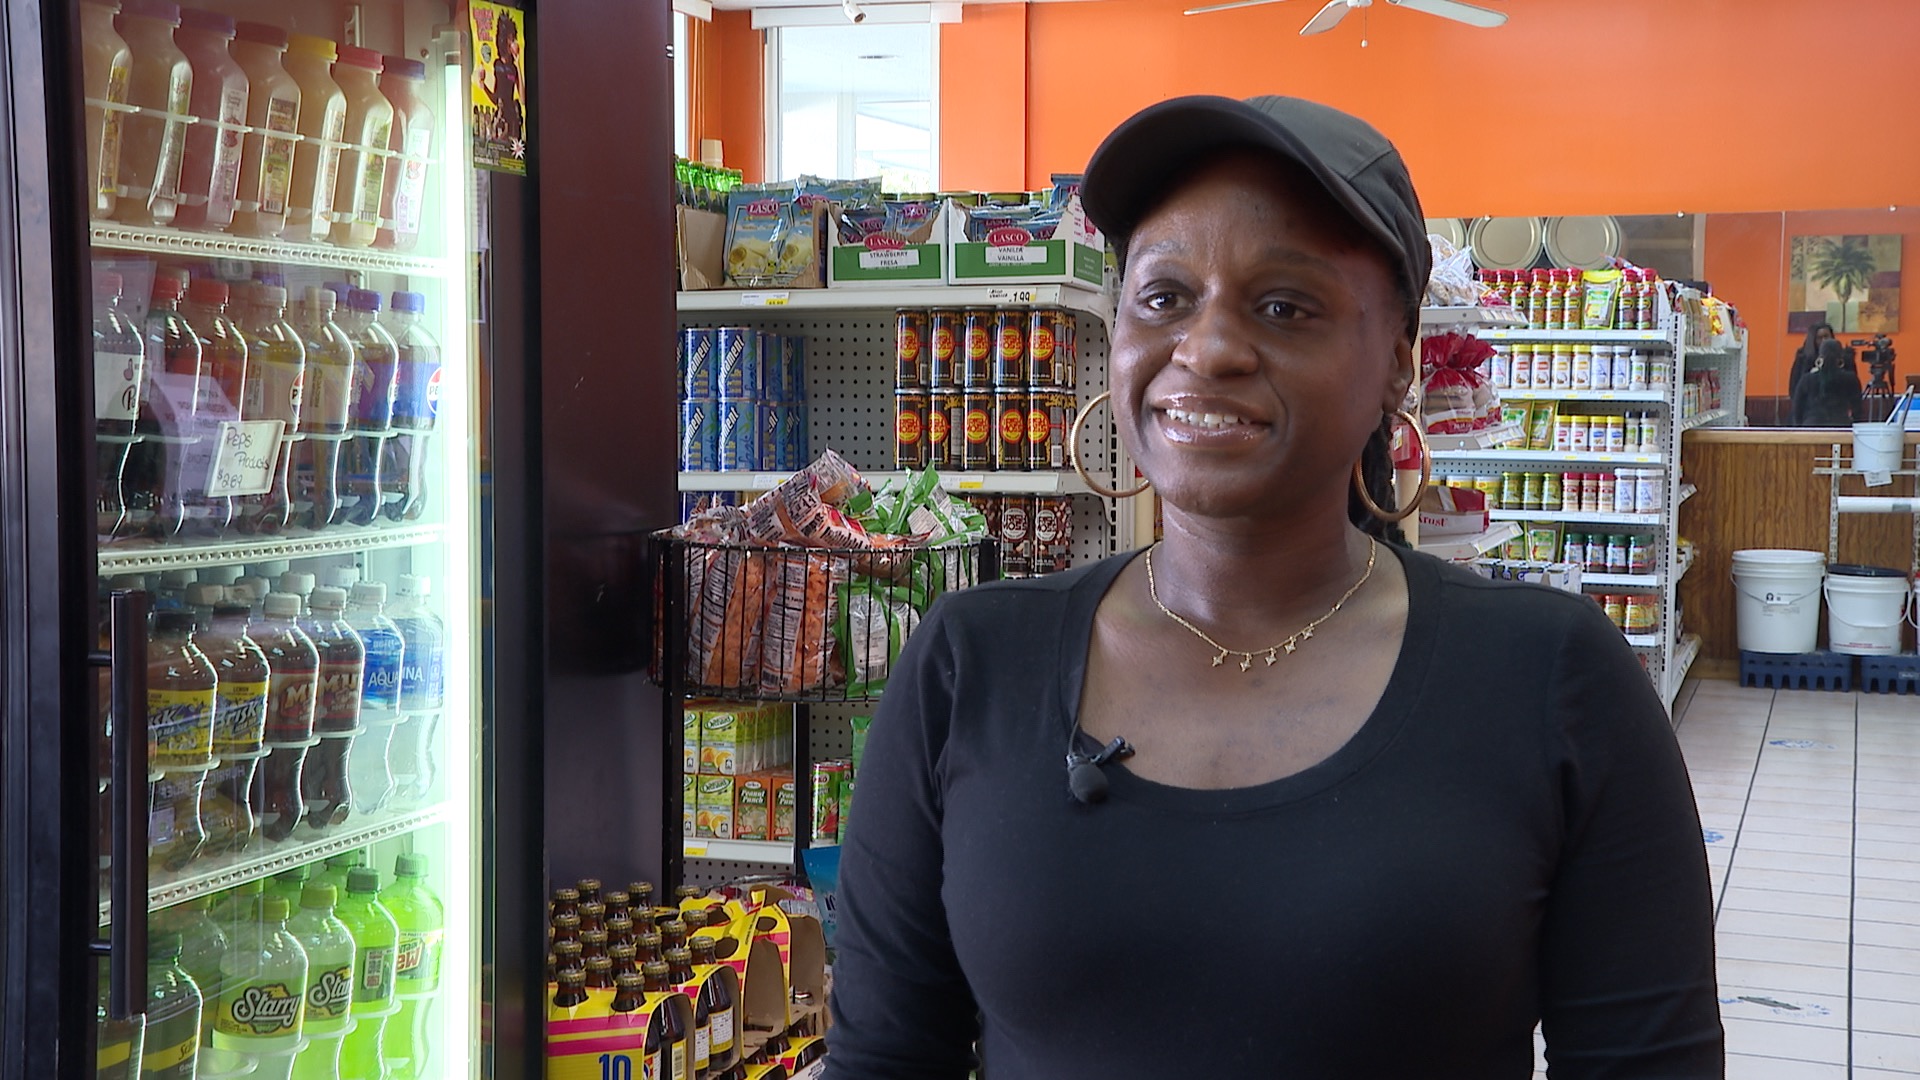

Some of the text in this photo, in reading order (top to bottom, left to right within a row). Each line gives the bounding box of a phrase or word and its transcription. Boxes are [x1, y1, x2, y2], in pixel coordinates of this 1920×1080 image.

[749, 204, 779, 213] LASCO
[993, 233, 1024, 242] LASCO
[869, 250, 908, 259] STRAWBERRY
[225, 426, 255, 450] Pepsi
[740, 789, 766, 797] Peanut
[742, 796, 764, 804] Punch
[232, 986, 301, 1029] Starry
[598, 1052, 632, 1080] 10
